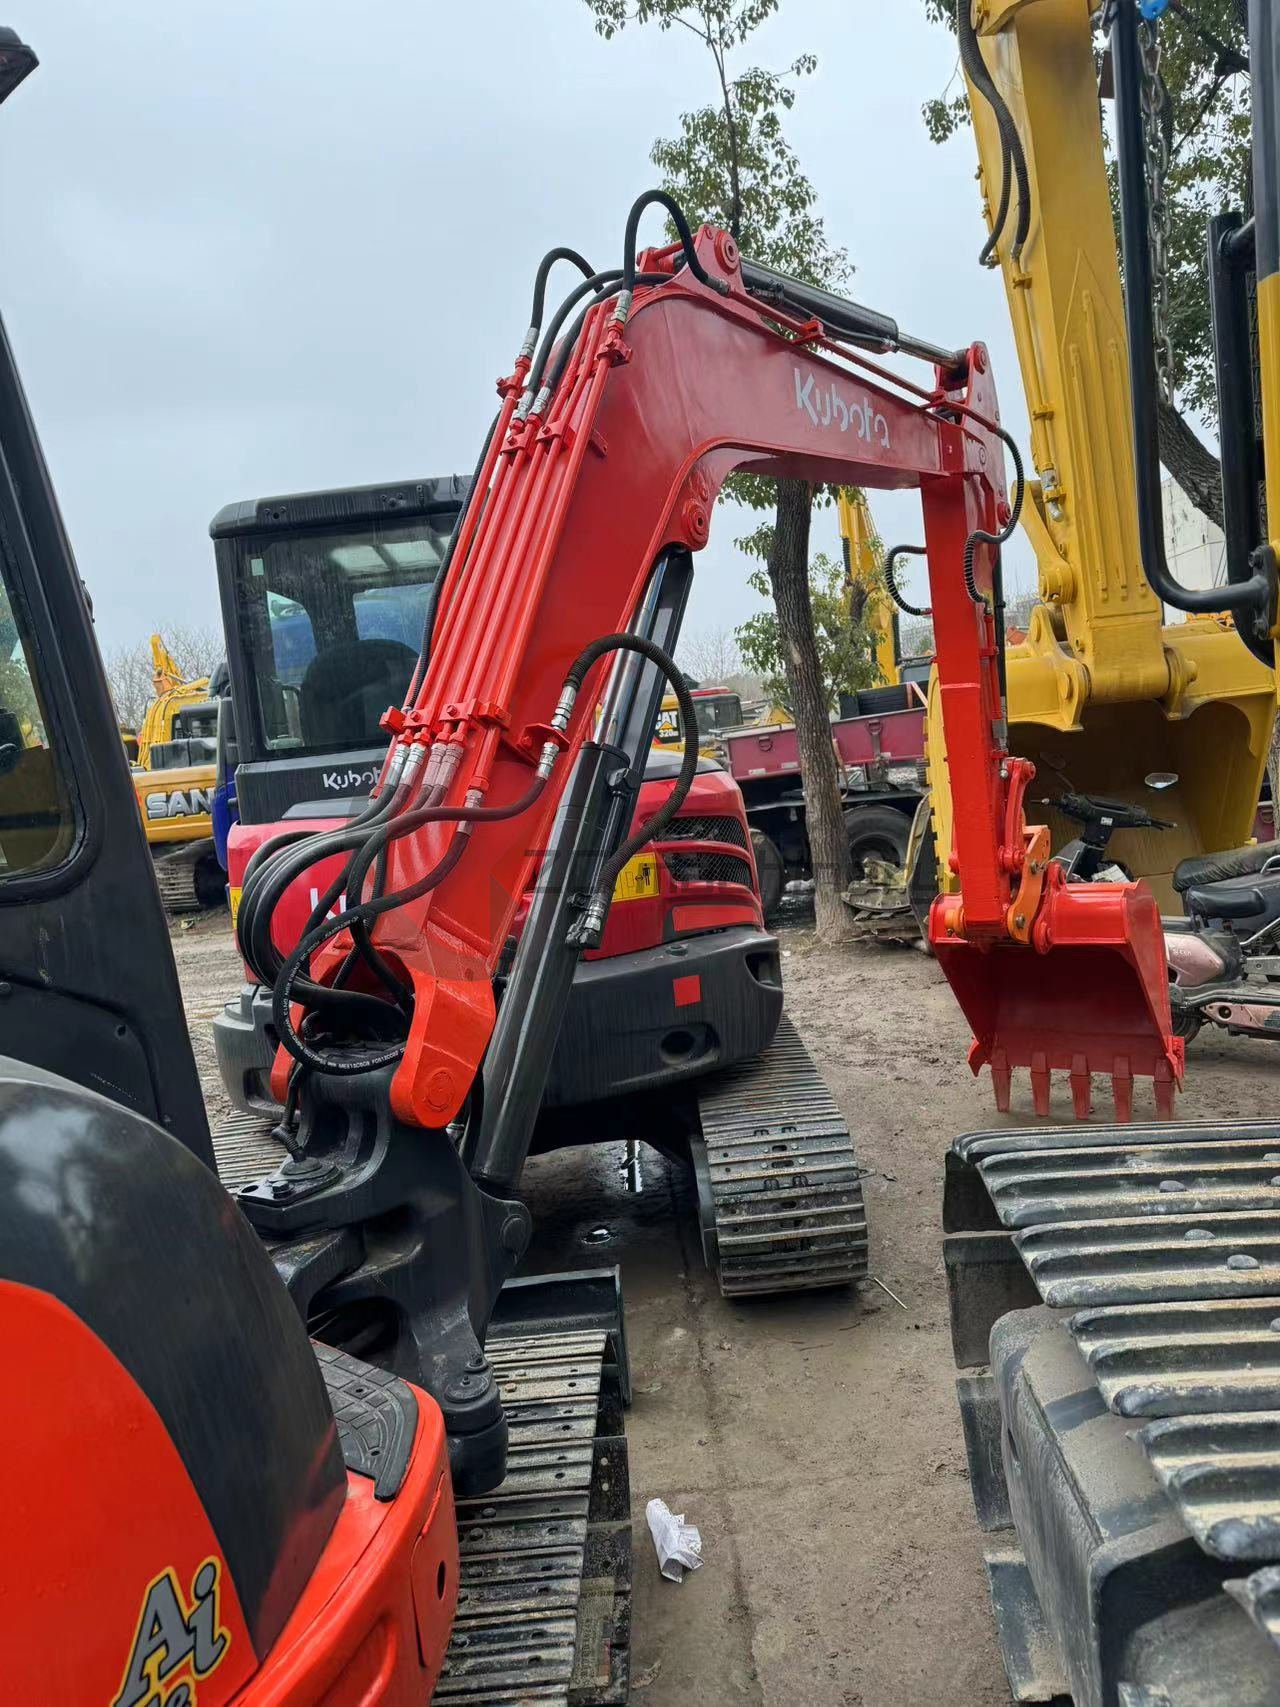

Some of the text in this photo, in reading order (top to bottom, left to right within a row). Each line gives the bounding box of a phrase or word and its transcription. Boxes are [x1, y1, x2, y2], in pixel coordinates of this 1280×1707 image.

[794, 368, 890, 449] Kubota
[322, 766, 381, 790] Kubot
[146, 787, 215, 819] SAN
